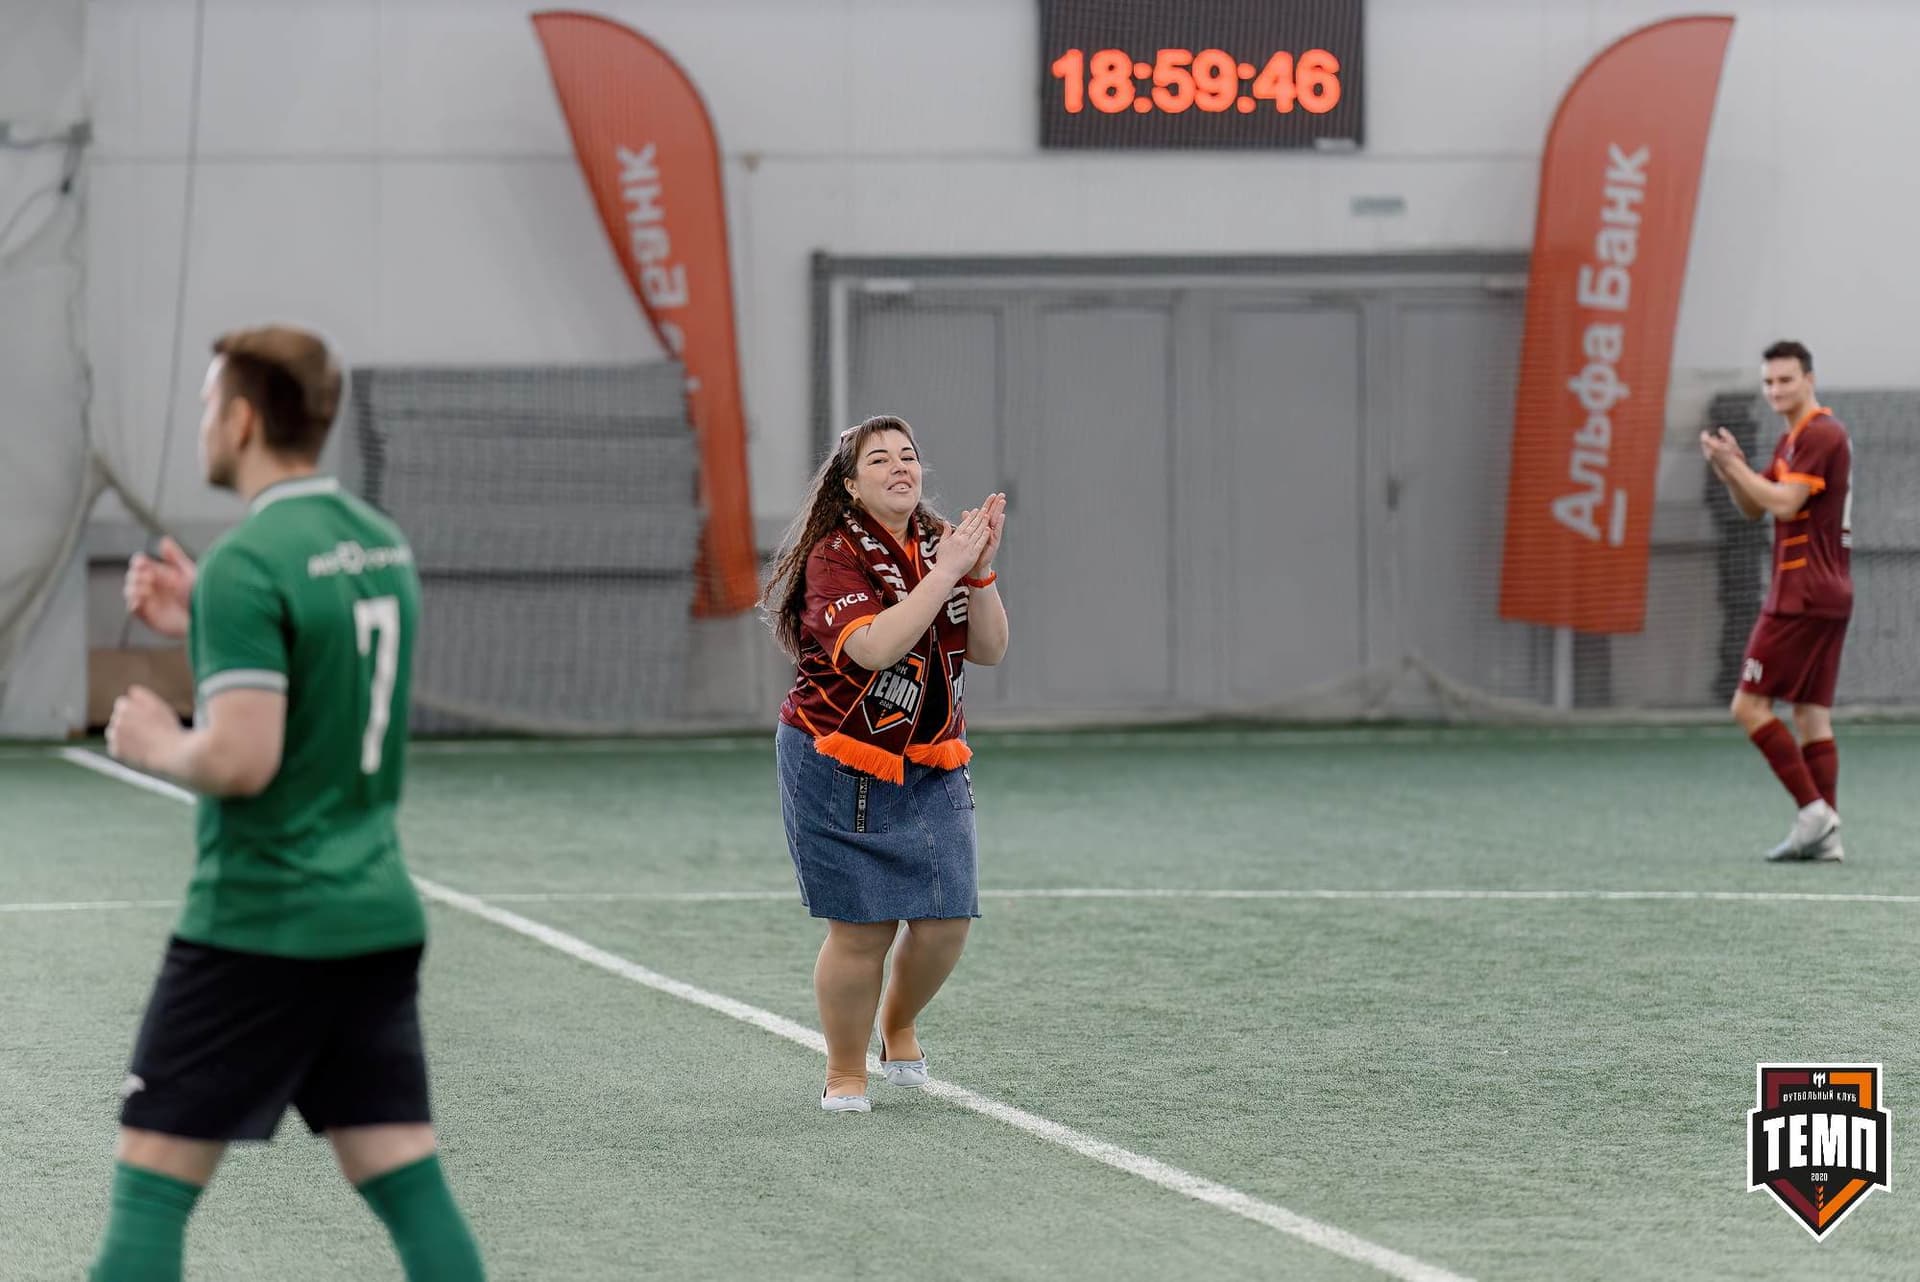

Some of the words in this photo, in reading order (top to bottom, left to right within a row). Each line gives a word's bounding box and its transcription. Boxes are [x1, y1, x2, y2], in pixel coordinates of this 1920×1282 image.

[1052, 49, 1341, 113] 18:59:46
[1576, 143, 1650, 311] Банк
[1552, 322, 1631, 543] Альфа
[353, 595, 398, 775] 7
